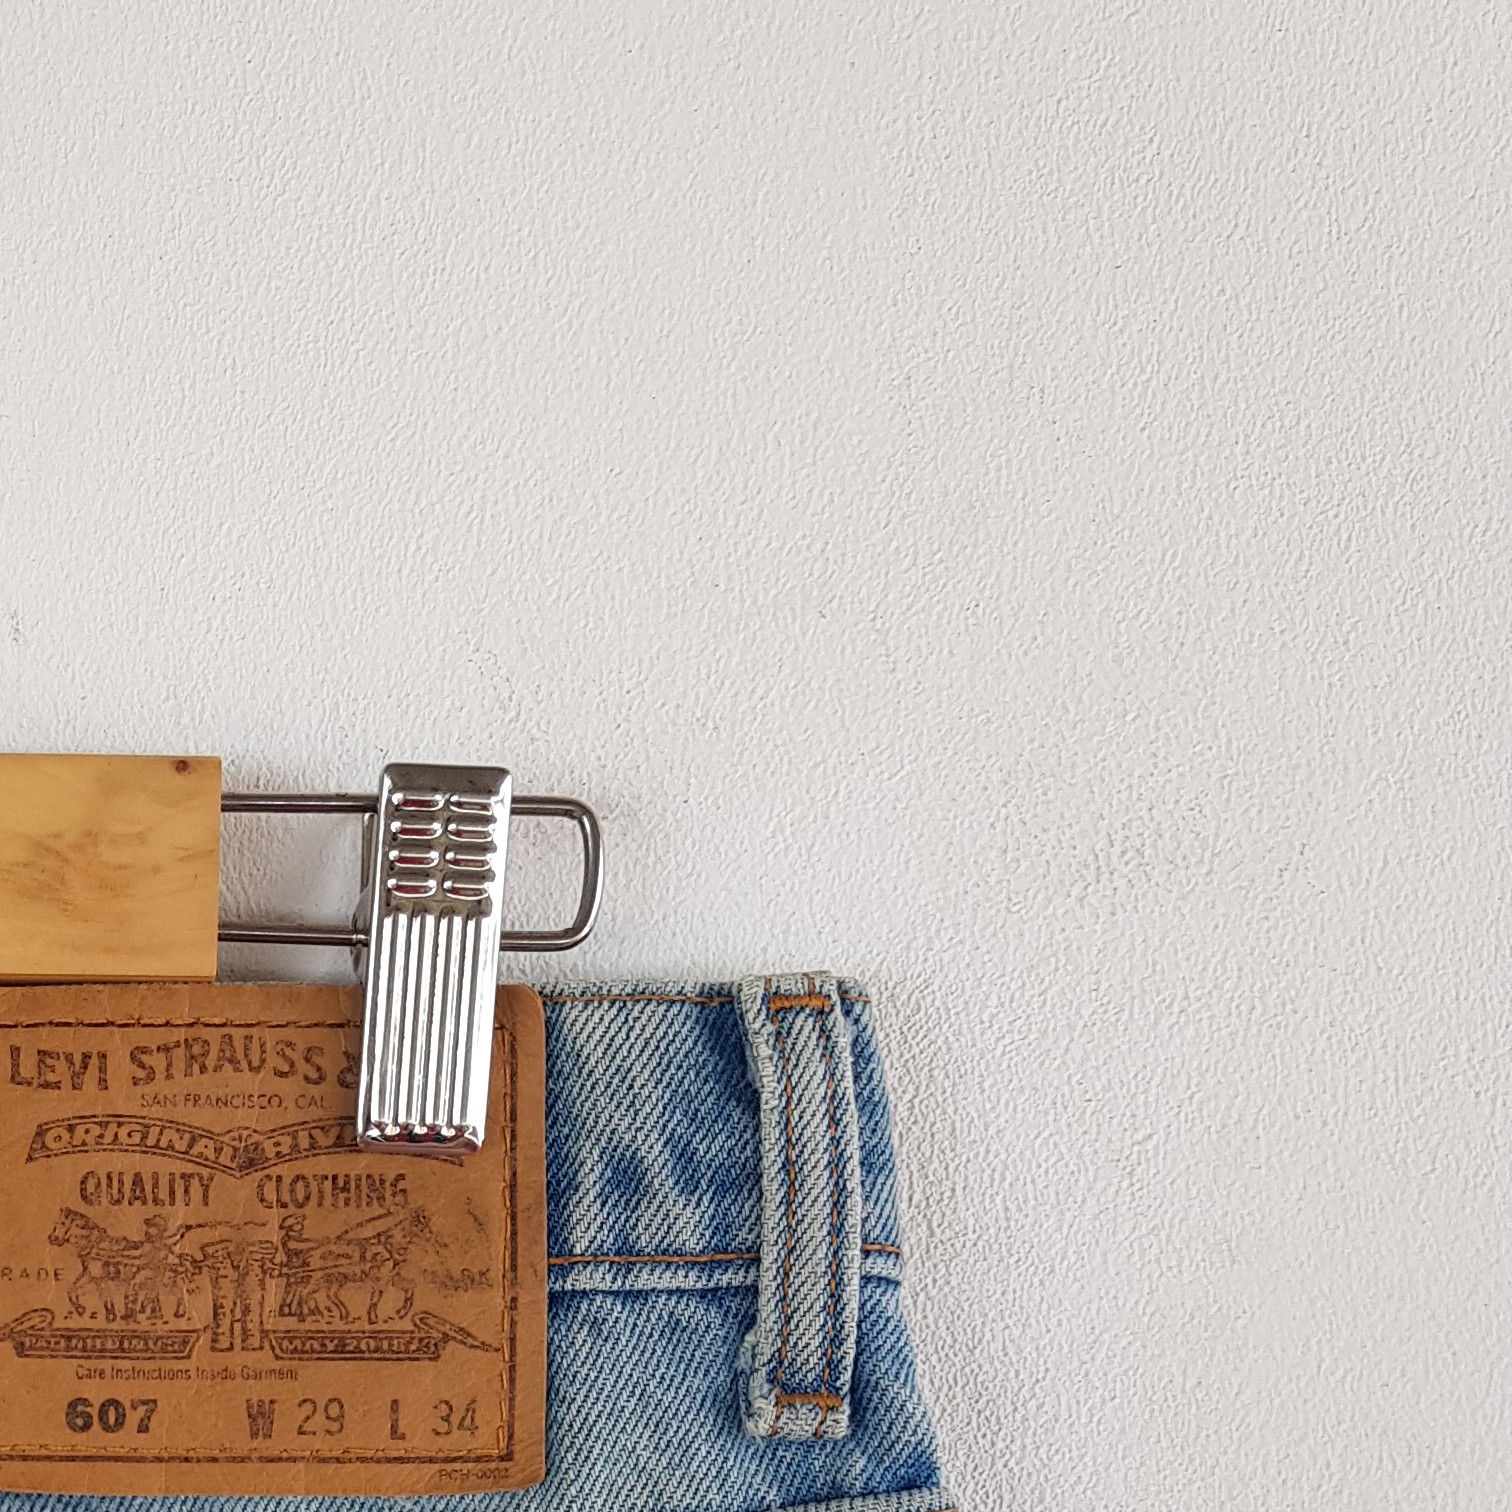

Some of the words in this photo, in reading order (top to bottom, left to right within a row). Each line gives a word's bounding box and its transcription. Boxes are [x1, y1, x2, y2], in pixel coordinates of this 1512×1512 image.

[10, 1044, 109, 1091] LEVI
[129, 1033, 327, 1086] STRAUSS
[140, 1093, 178, 1109] SAN
[184, 1093, 288, 1112] FRANCISCO,
[44, 1121, 236, 1167] ORIGINAL
[79, 1171, 215, 1207] QUALITY
[256, 1173, 409, 1209] CLOTHING
[75, 1364, 106, 1380] Care
[111, 1365, 192, 1381] Instructions
[196, 1365, 237, 1381] Inside
[240, 1365, 298, 1381] Garment
[64, 1397, 158, 1434] 607
[245, 1399, 276, 1440] W
[296, 1397, 345, 1436] 29
[390, 1399, 406, 1441] L
[431, 1399, 479, 1437] 34
